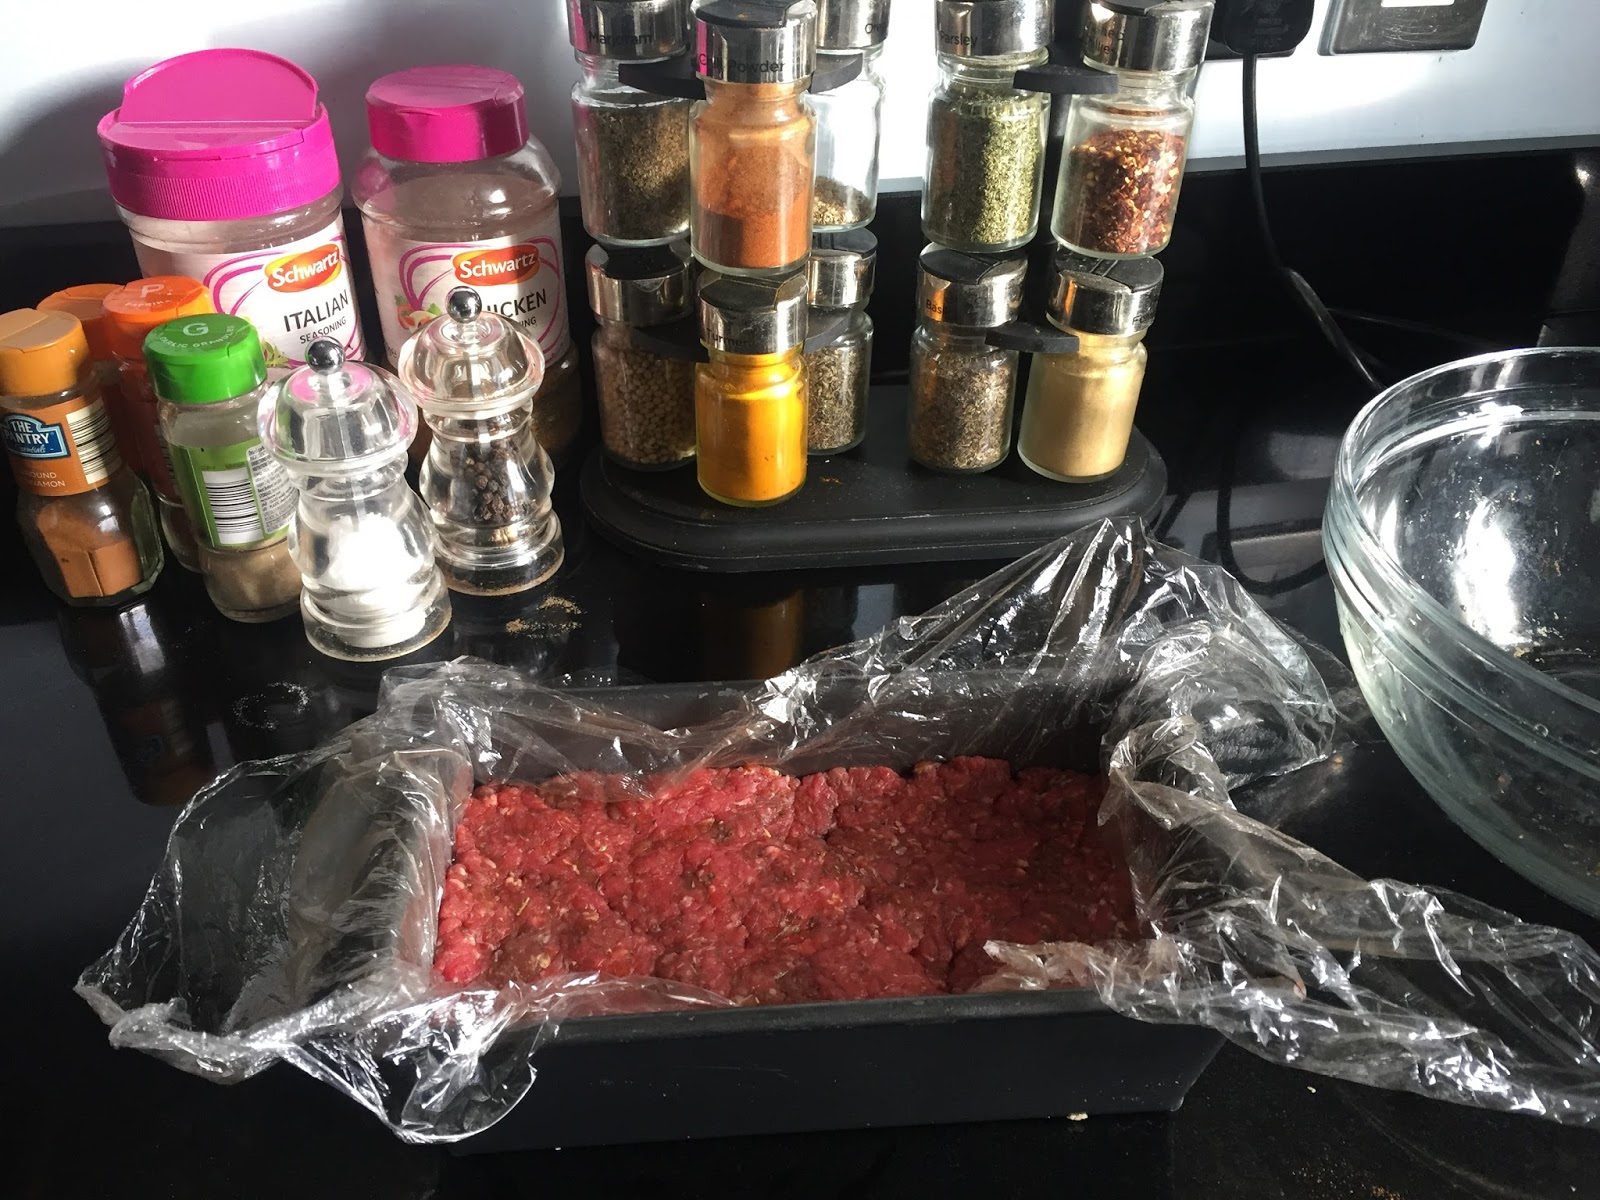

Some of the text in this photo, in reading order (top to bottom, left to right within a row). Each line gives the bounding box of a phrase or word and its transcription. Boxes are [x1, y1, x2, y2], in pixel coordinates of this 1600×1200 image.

[271, 250, 340, 289] Schwartz
[459, 252, 537, 280] Schwartz
[283, 288, 350, 333] ITALIAN
[183, 322, 209, 336] G
[299, 316, 347, 345] SEASONING
[4, 429, 49, 444] PANTRY
[10, 420, 33, 433] THE
